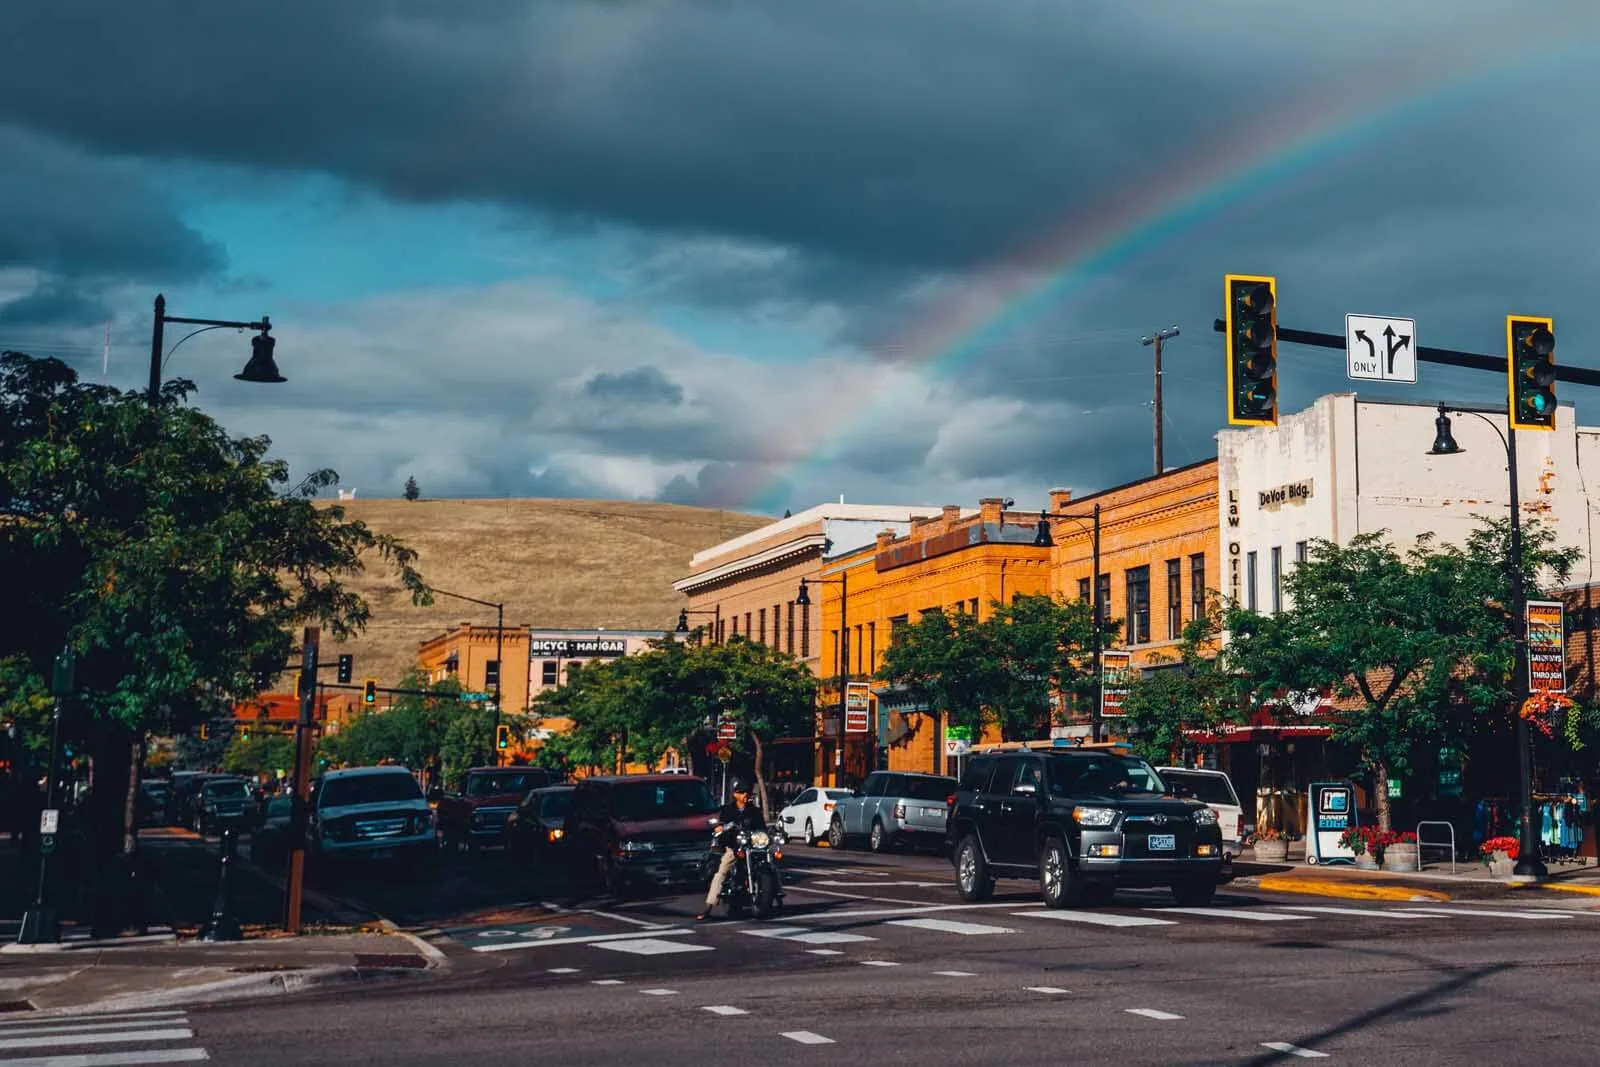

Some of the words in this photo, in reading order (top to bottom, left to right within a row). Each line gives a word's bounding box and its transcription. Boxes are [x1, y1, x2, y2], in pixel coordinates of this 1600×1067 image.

[1353, 361, 1377, 373] ONLY
[1260, 488, 1285, 506] DeVoe
[1228, 490, 1240, 527] Law
[1532, 662, 1561, 672] MAY
